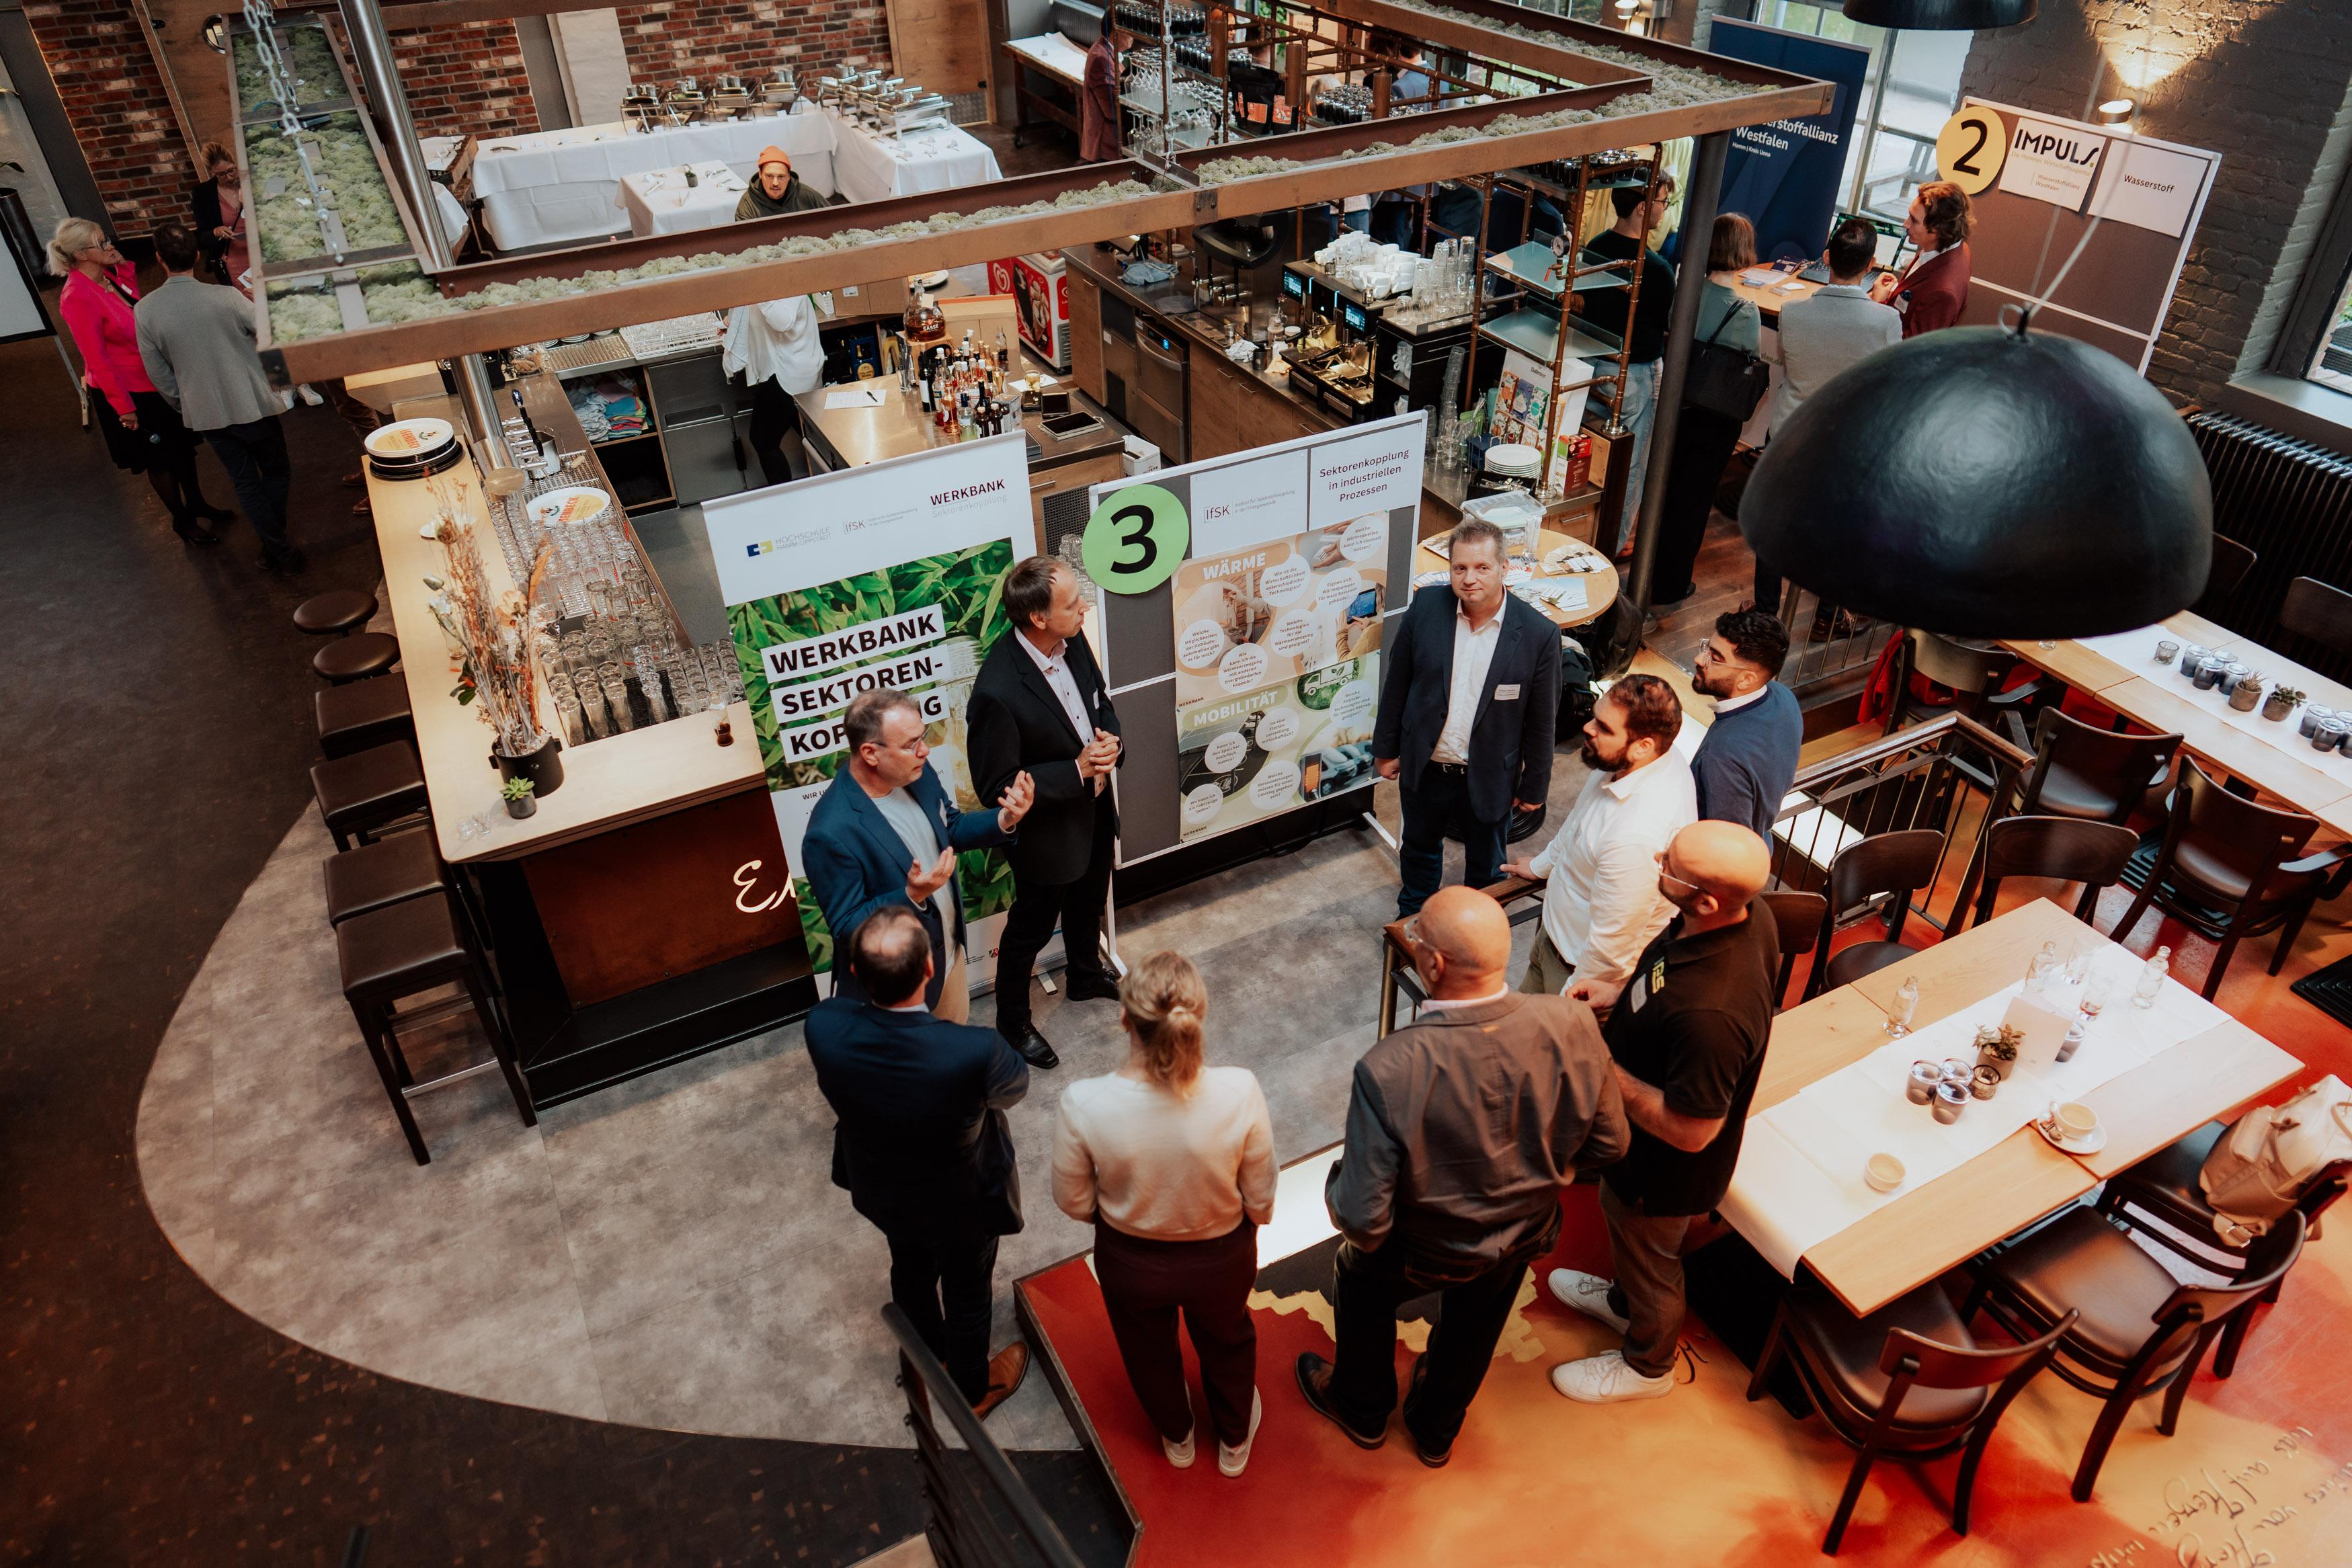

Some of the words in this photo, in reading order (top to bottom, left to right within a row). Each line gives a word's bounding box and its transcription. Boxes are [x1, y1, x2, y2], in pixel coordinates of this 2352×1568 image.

[1736, 126, 1789, 150] Westfalen
[1760, 149, 1771, 157] Unna
[1953, 118, 1988, 176] 2
[2035, 181, 2060, 190] Westfalen
[2038, 173, 2080, 190] Wasserstoffallianz
[2124, 173, 2175, 194] Wasserstoff
[1320, 449, 1410, 478] Sektorenkopplung
[1329, 481, 1338, 490] in
[1340, 466, 1402, 487] industriellen
[930, 479, 1005, 505] WERKBANK
[1340, 483, 1387, 502] Prozessen
[932, 495, 1008, 518] Sektorenkopplung
[775, 526, 831, 544] HOCHSCHULE
[1110, 504, 1158, 574] 3
[1203, 552, 1266, 581] WÄRME
[1265, 571, 1305, 585] Wirtschaftlichkeit
[1265, 577, 1305, 591] unterschiedlicher
[1269, 583, 1301, 595] Technologien?
[1280, 623, 1309, 633] Technologien
[770, 612, 938, 674] WERKBANK
[1184, 633, 1217, 645] Möglichkeiten
[1274, 633, 1313, 646] Wärmeerzeugung
[1289, 638, 1309, 649] geeignet?
[1183, 647, 1209, 658] automation
[1201, 651, 1215, 659] mich?
[1223, 659, 1262, 673] Wärmeerzeugung
[1238, 667, 1257, 675] anderen
[1224, 671, 1262, 684] Energiebedarfen
[1233, 679, 1254, 688] koppeln?
[781, 657, 943, 715] SEKTOREN-
[1178, 697, 1204, 707] WERKBANK
[1194, 690, 1278, 727] MOBILITÄT
[803, 792, 818, 800] WIR
[1183, 826, 1207, 837] WERKBANK
